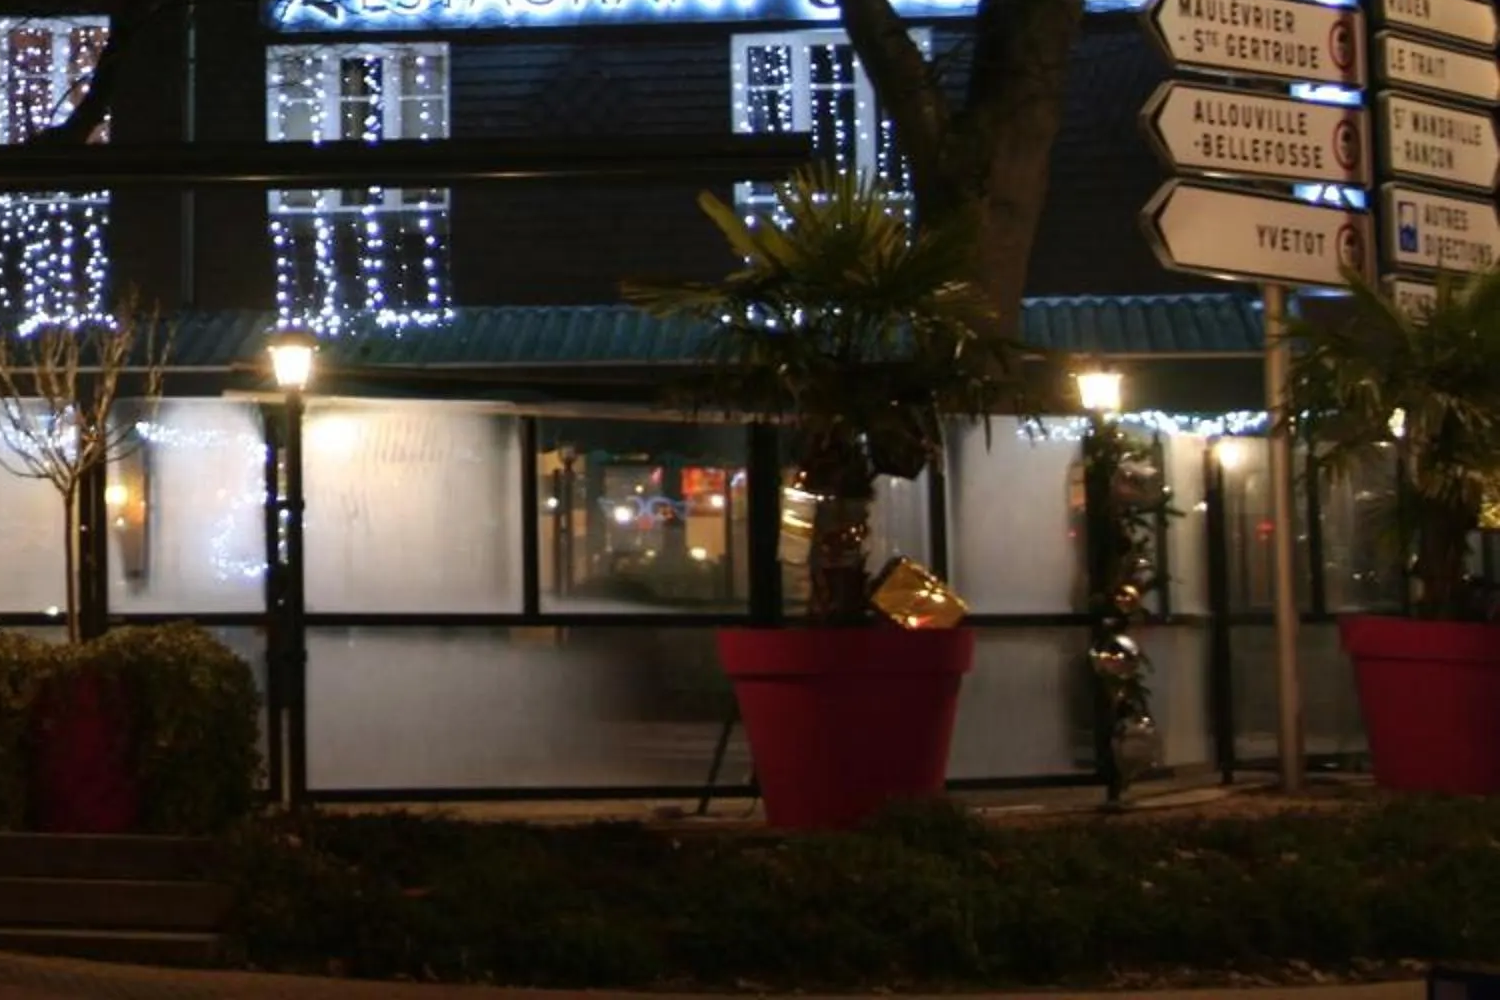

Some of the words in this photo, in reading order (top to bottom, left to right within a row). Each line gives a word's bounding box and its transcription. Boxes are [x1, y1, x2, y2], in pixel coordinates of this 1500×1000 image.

[1225, 33, 1319, 70] GERTRUDE
[1391, 47, 1405, 72] LE
[1411, 51, 1446, 78] TRAIT
[1193, 99, 1308, 136] ALLOUVILLE
[1411, 111, 1484, 147] WANDRILLE
[1424, 204, 1468, 232] AUTRES
[1257, 224, 1326, 258] YVETOT
[1424, 233, 1493, 266] DIRECTIONS
